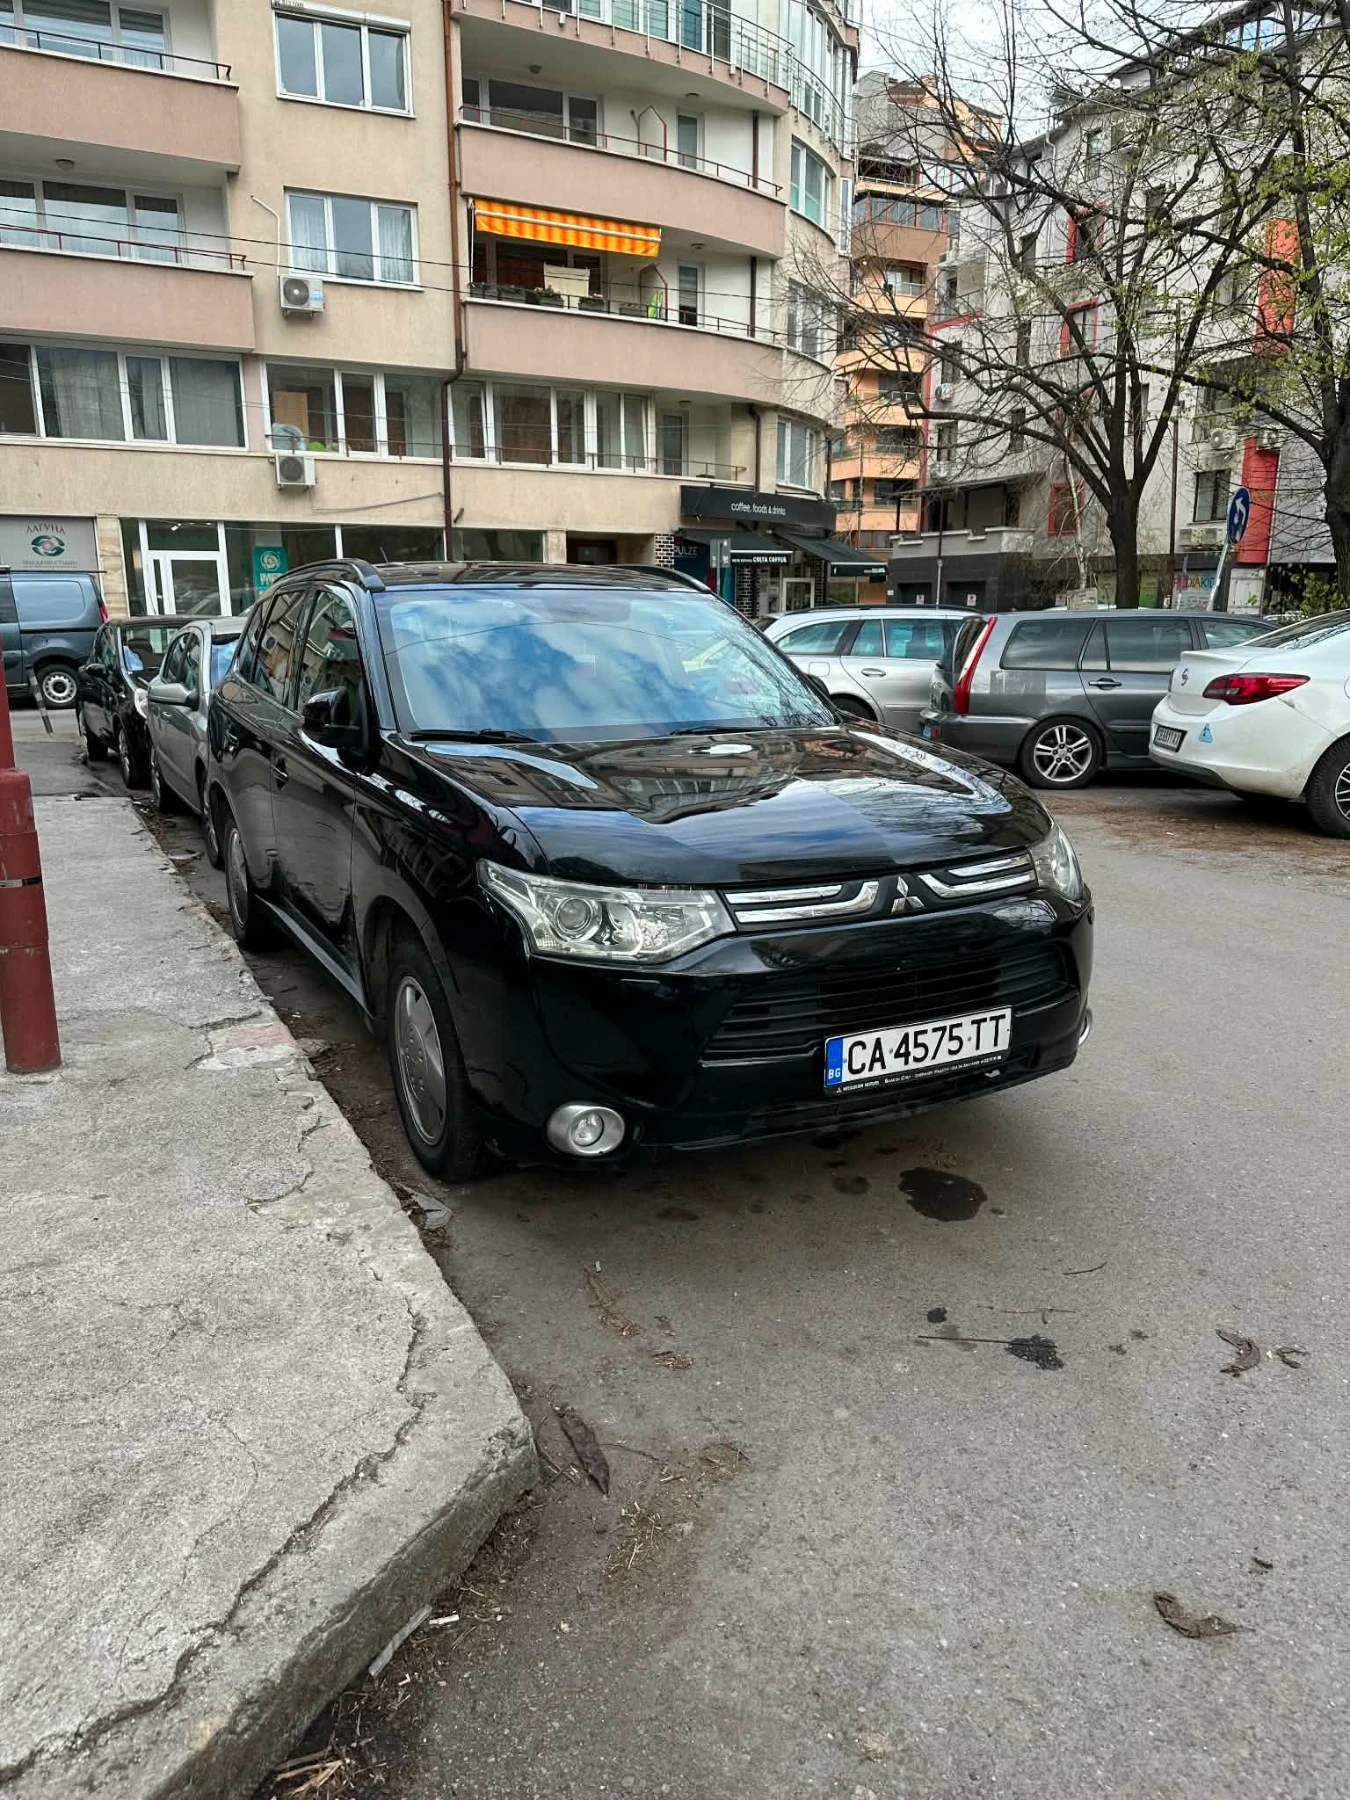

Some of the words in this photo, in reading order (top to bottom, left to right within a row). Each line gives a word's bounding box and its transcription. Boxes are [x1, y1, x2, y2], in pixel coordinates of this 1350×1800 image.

[847, 1037, 886, 1075] CA
[894, 1022, 963, 1066] 4575
[971, 1013, 1006, 1051] TT
[828, 1067, 841, 1079] BG
